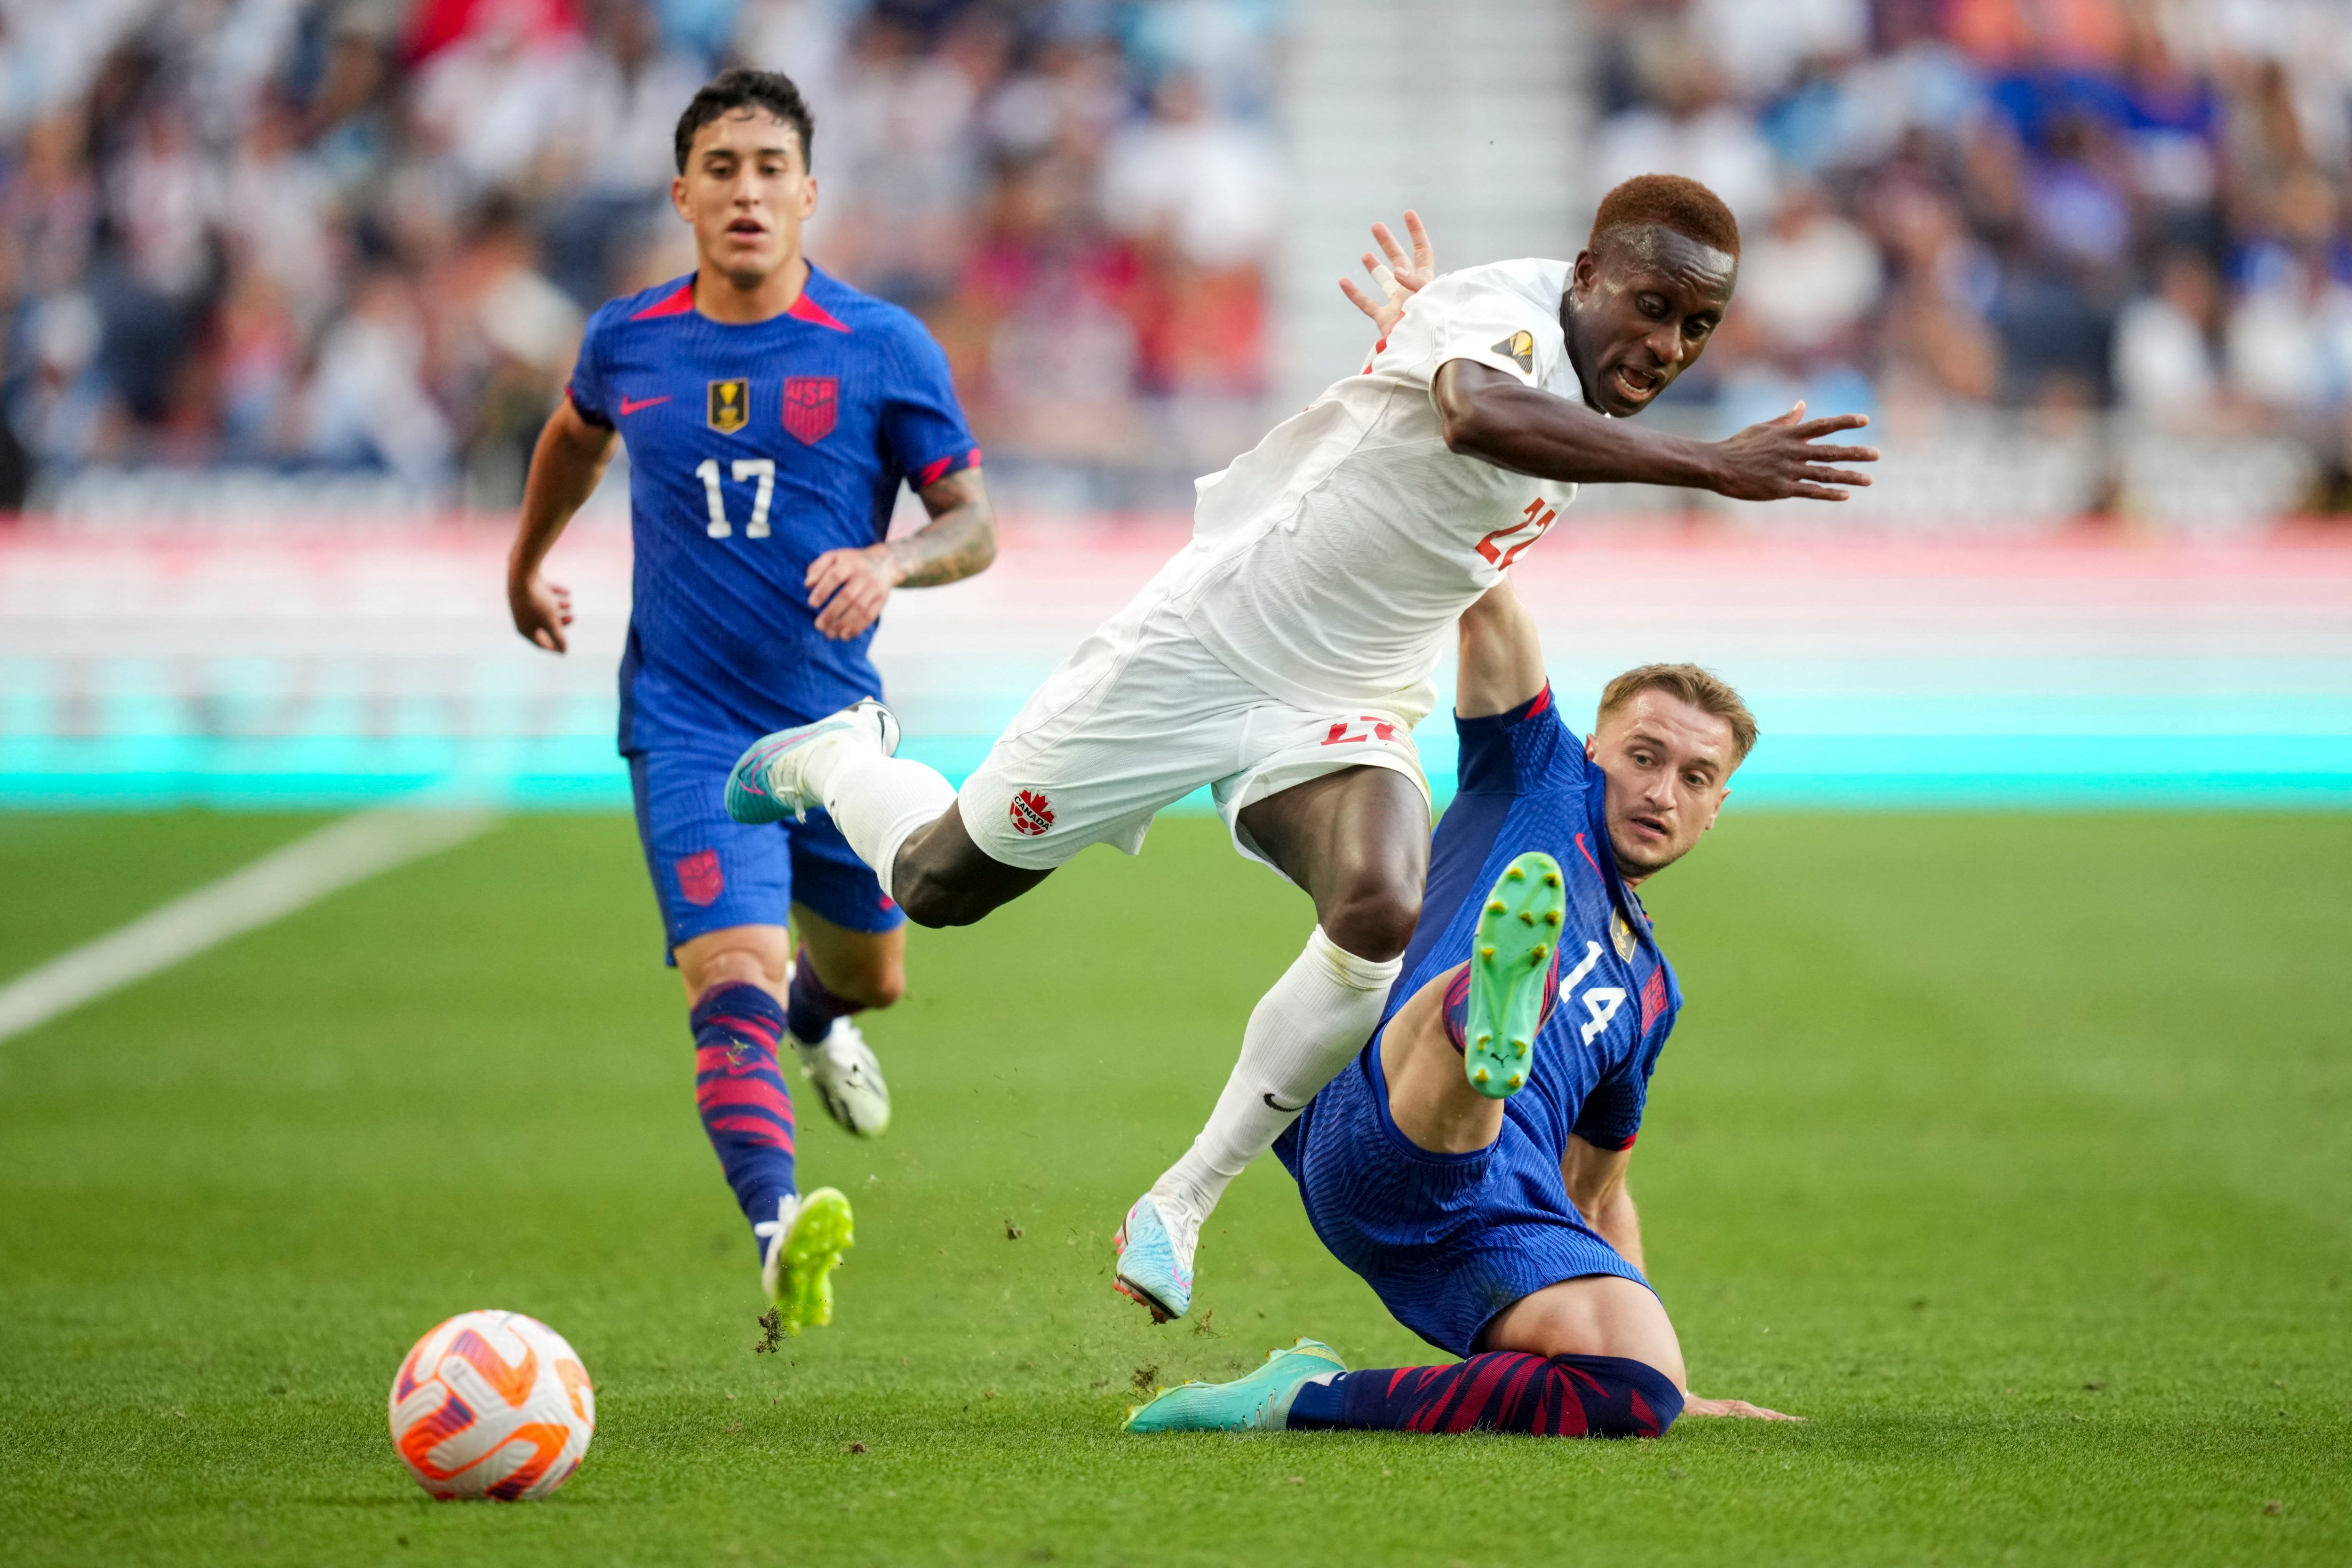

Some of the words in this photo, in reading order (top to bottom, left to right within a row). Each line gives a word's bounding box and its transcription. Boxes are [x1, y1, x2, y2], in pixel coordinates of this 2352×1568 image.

[788, 380, 833, 405] USA
[695, 458, 776, 539] 17
[1474, 497, 1556, 572] 22
[1014, 796, 1049, 830] CANADA
[1560, 940, 1627, 1047] 14
[1652, 971, 1665, 1014] USA
